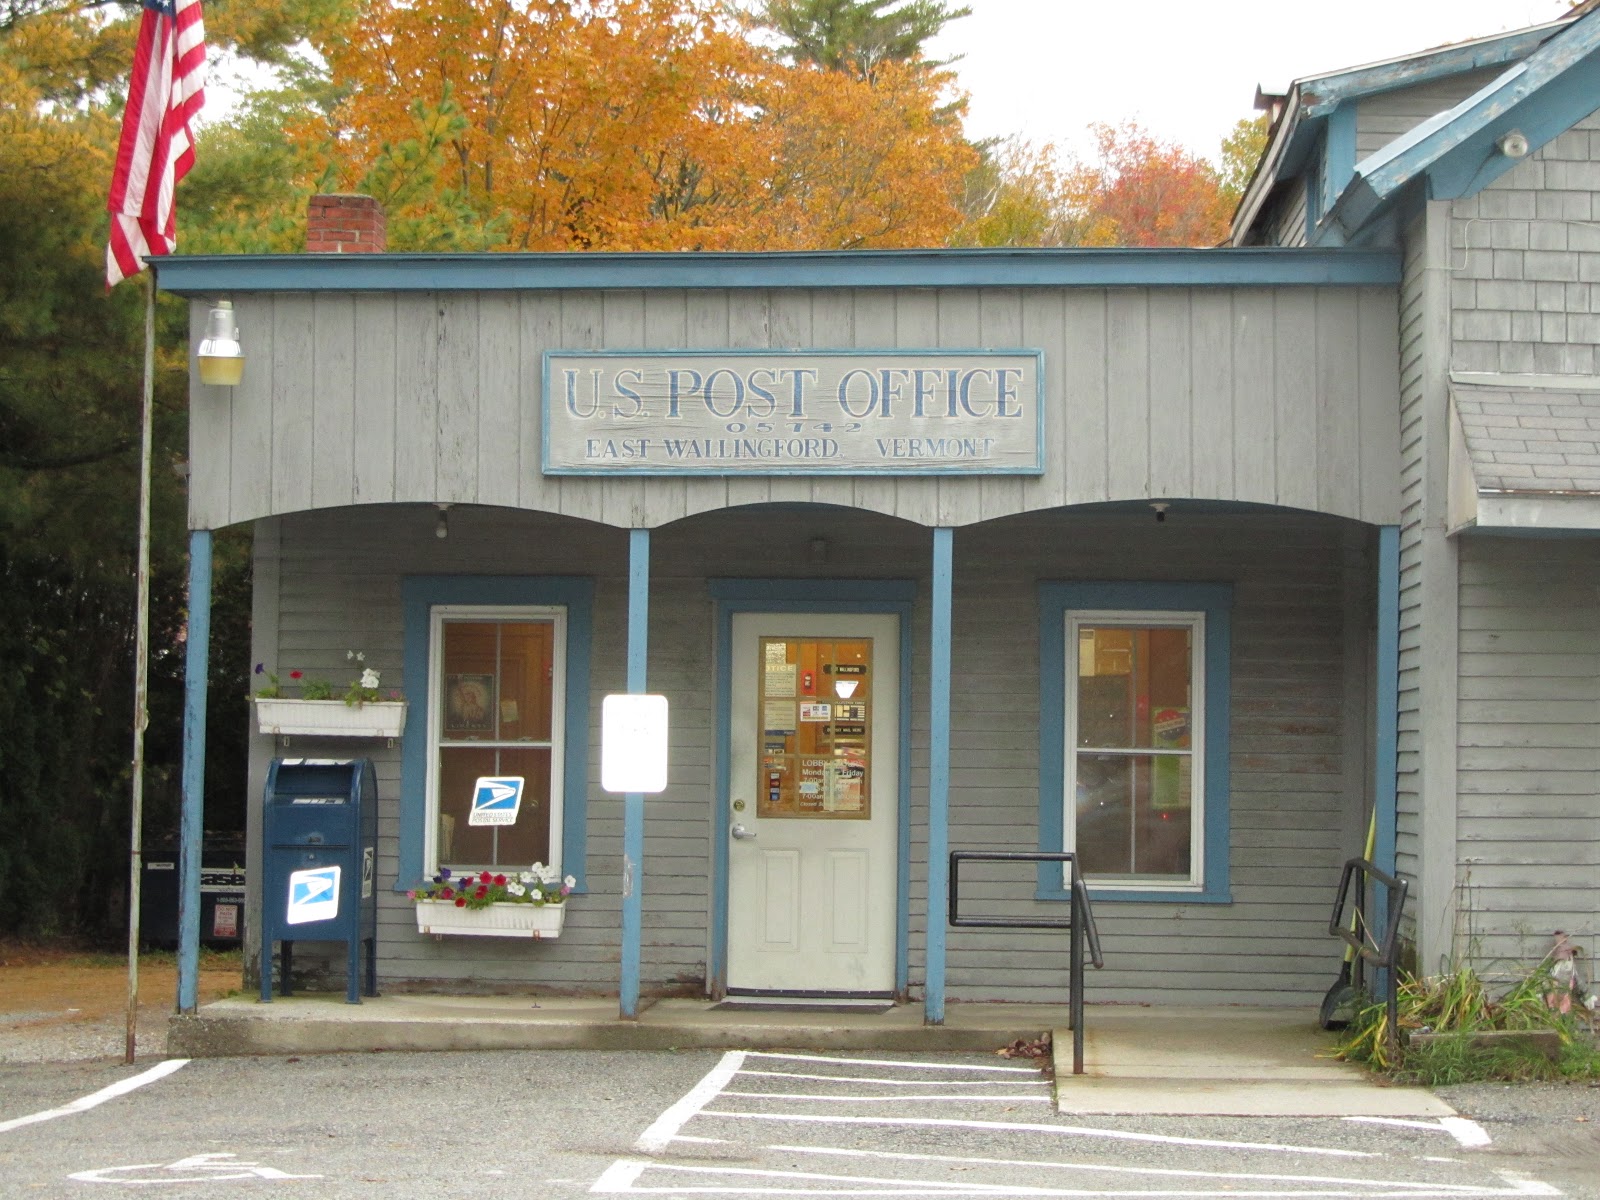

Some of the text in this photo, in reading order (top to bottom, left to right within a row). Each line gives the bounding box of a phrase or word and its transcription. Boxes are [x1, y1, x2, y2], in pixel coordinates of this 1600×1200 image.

[563, 368, 1024, 420] U.S. POST OFFICE
[726, 422, 862, 433] 05742
[586, 438, 995, 459] EAST WALLINGFORD, VERMONT
[842, 768, 864, 778] Friday
